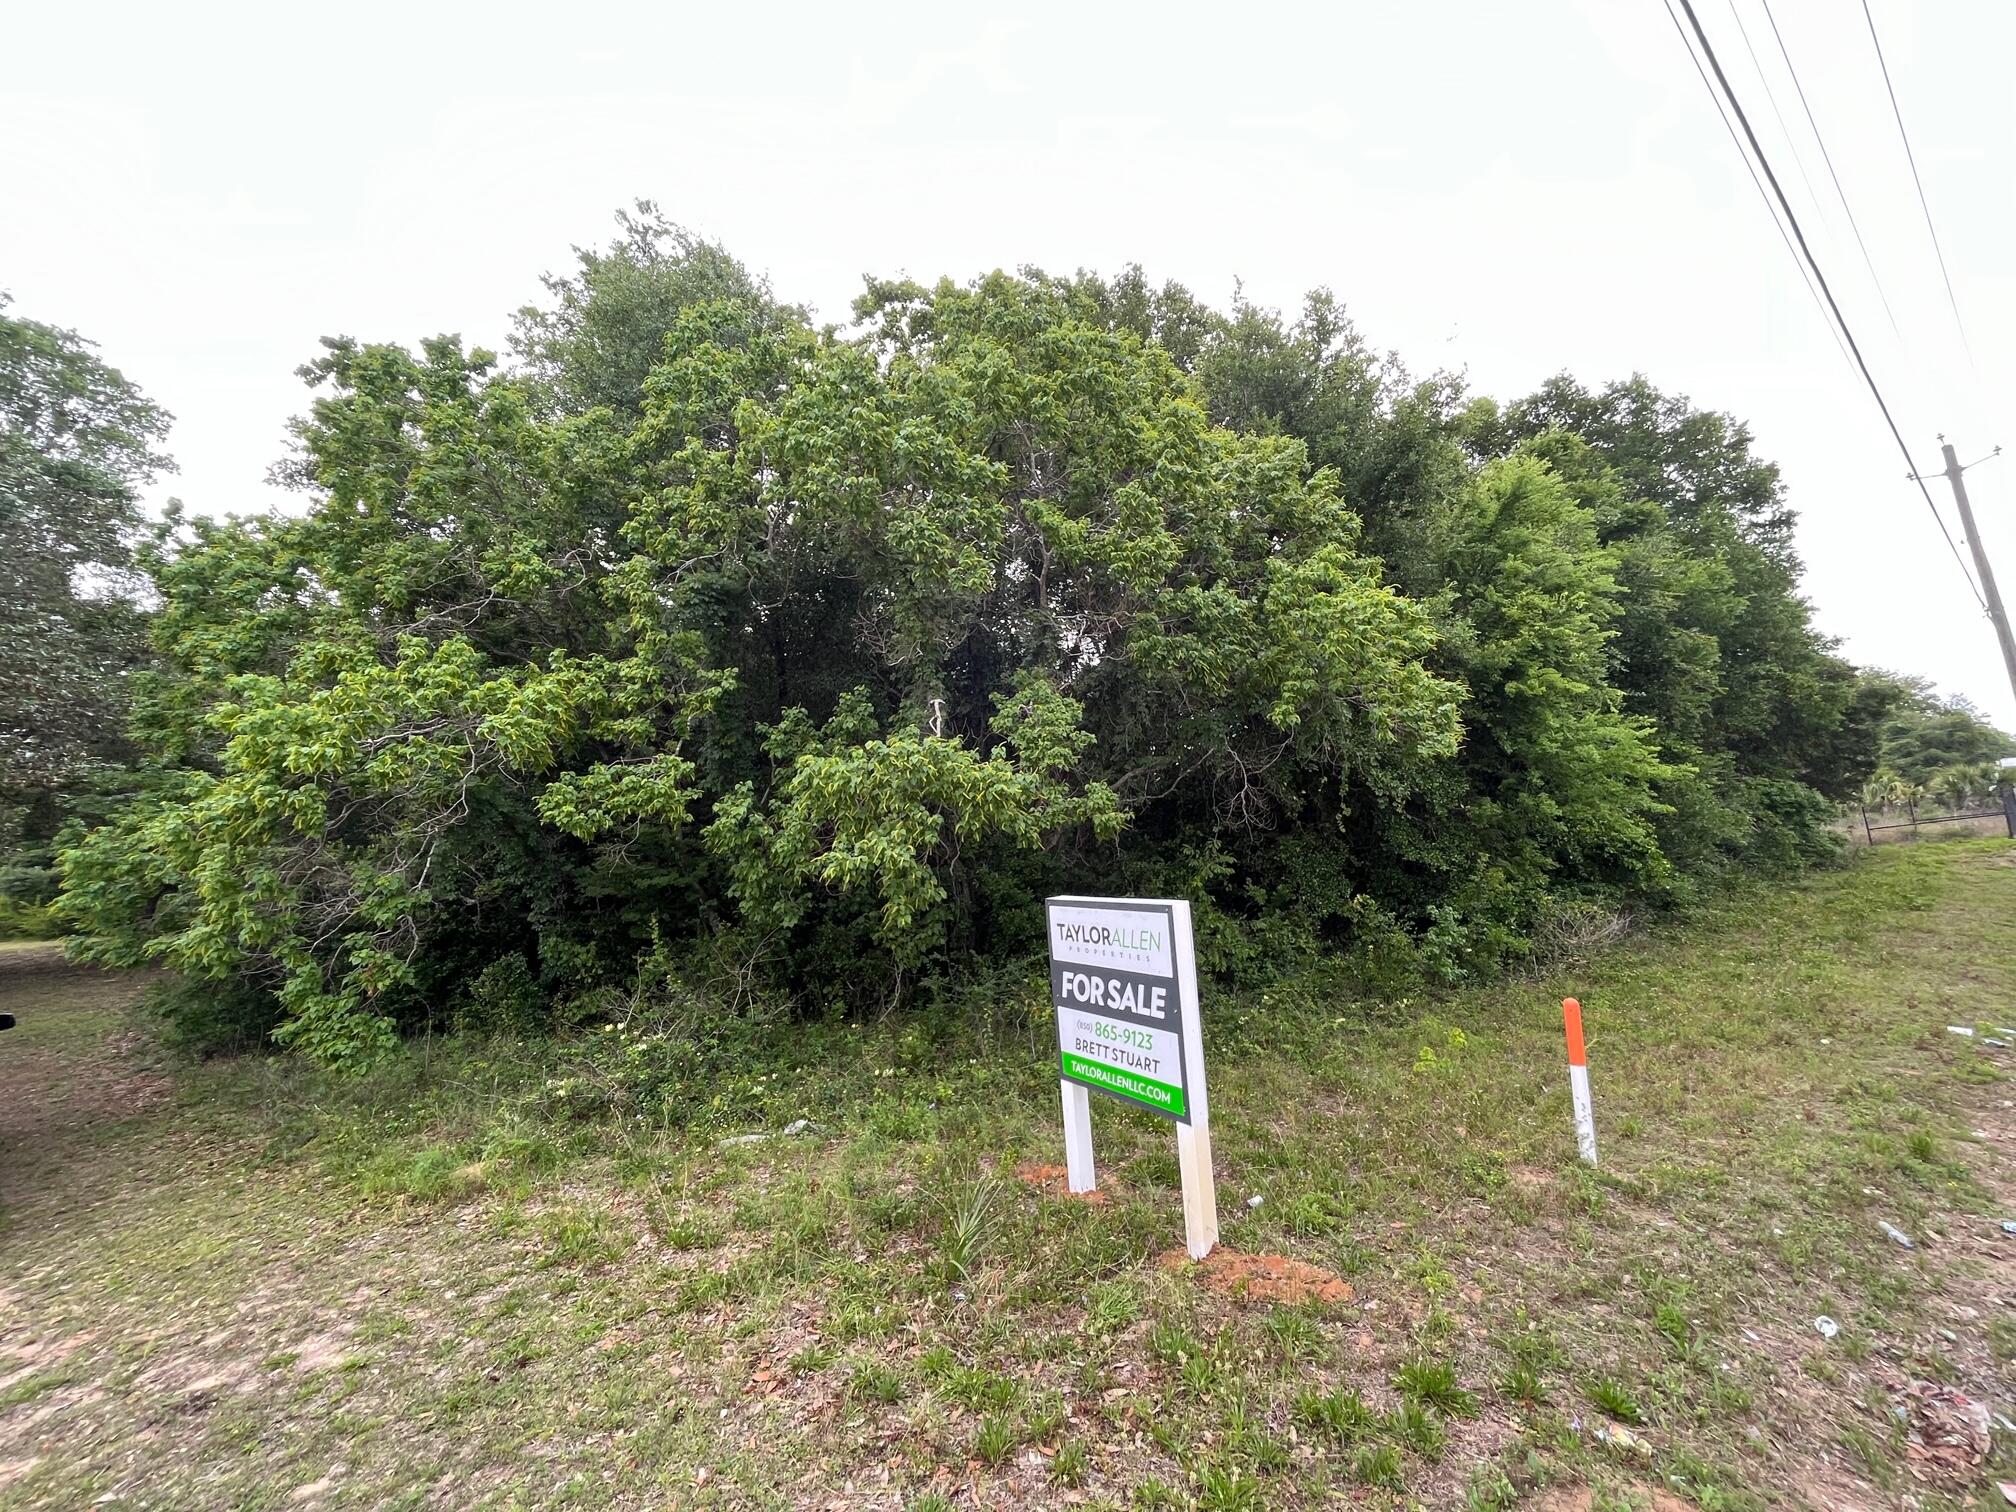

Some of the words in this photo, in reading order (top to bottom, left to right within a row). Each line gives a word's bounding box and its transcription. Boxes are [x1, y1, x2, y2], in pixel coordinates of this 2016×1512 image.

[1068, 945, 1151, 963] PROPERTIES
[1062, 971, 1105, 1007] FOR
[1107, 978, 1166, 1020] SALE
[1076, 1019, 1093, 1034] (850)
[1094, 1021, 1154, 1051] 865-9123
[1075, 1037, 1110, 1059] BRETT
[1111, 1048, 1161, 1074] STUART
[1071, 1060, 1171, 1105] TAYLORALLENLLC.COM
